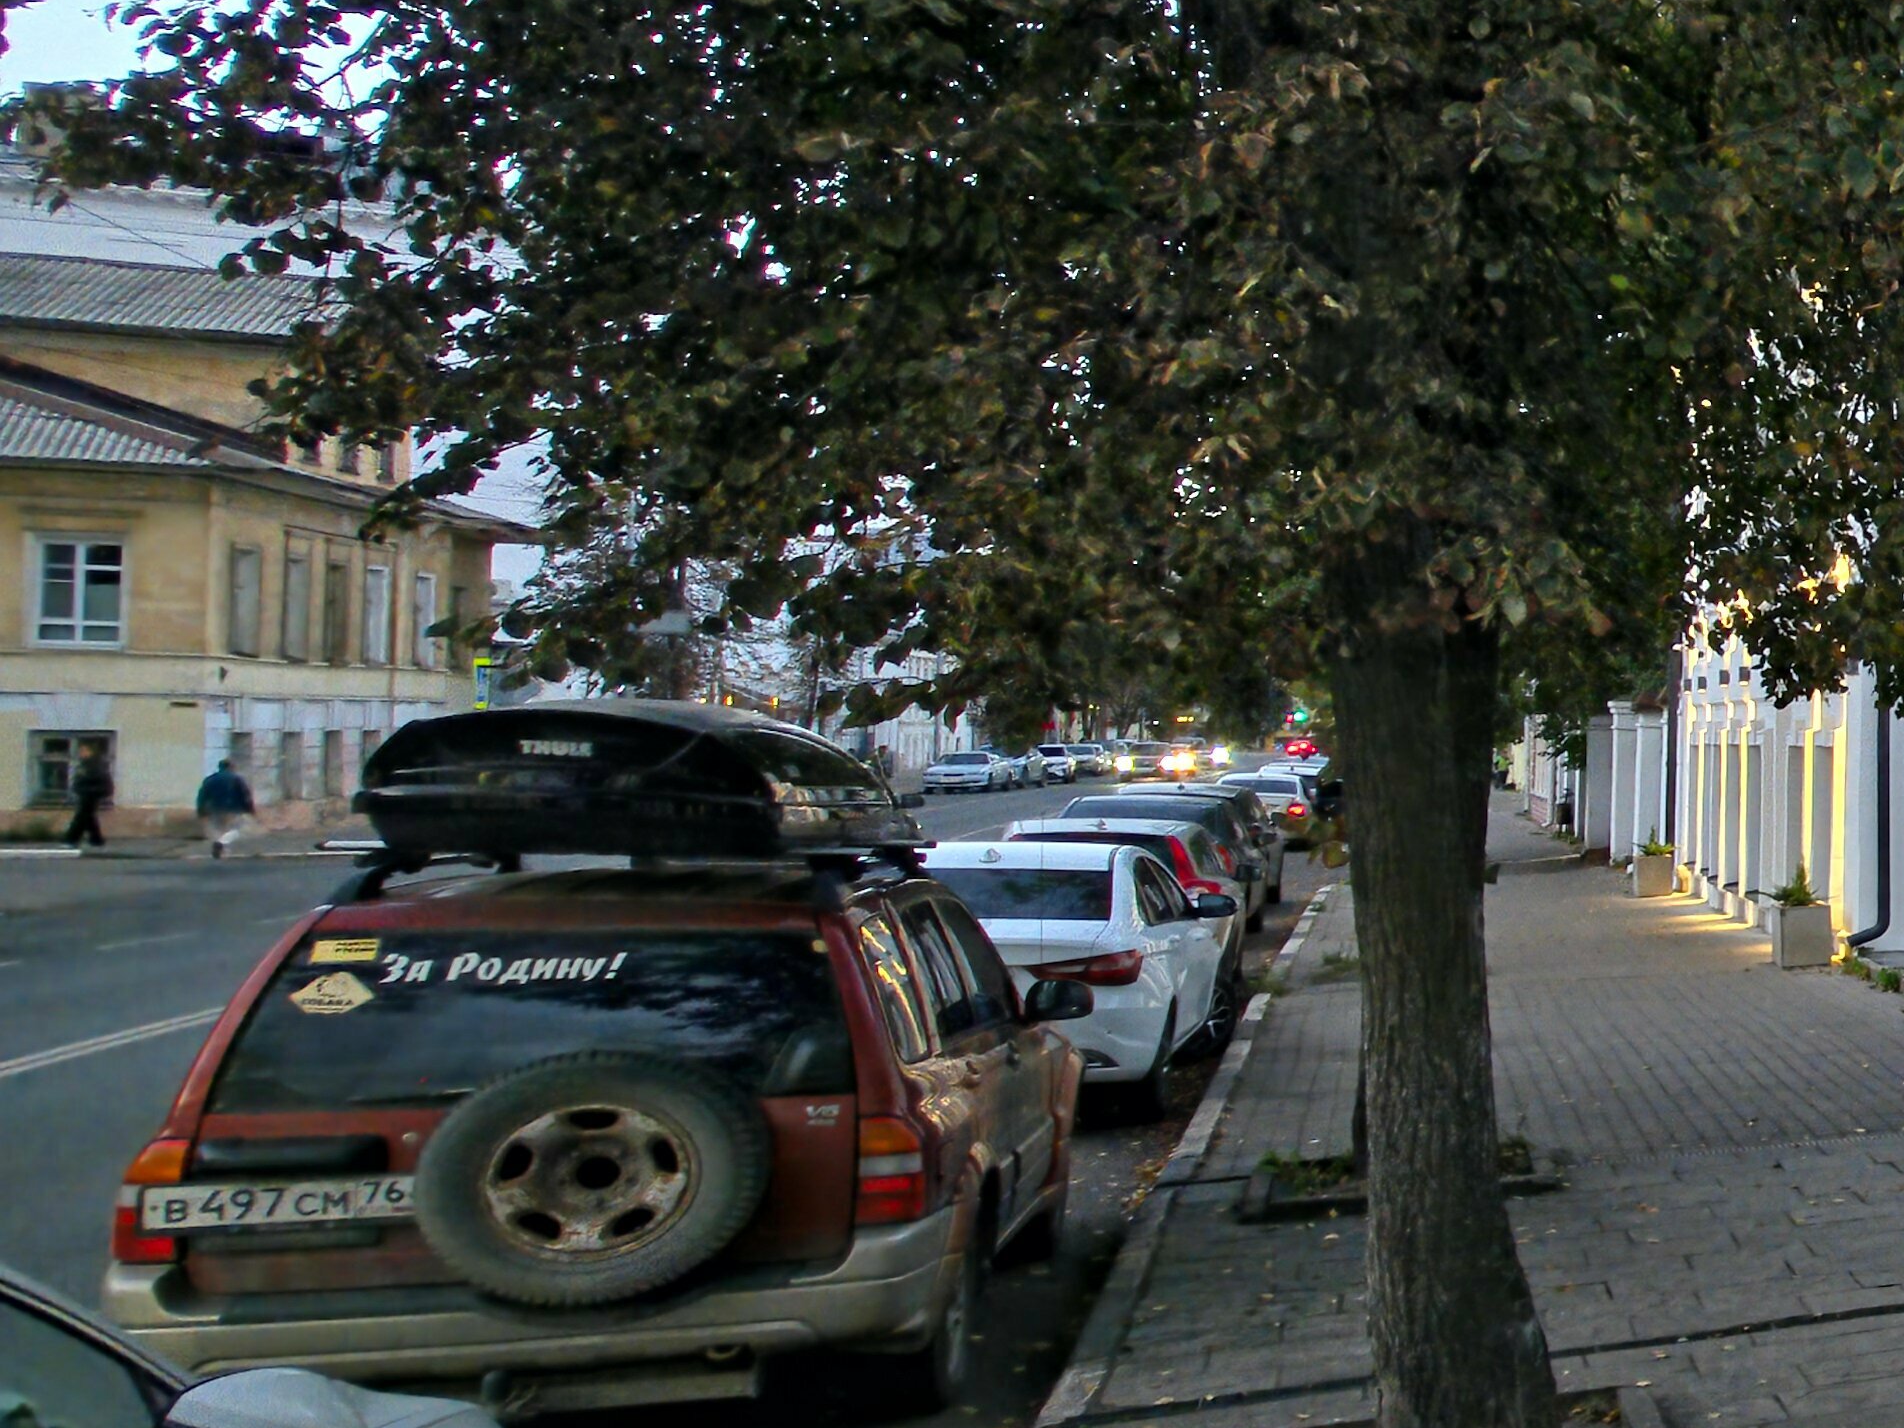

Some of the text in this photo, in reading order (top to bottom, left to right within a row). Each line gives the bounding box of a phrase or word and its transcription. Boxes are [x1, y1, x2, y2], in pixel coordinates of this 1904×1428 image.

[519, 739, 592, 757] THULE
[379, 952, 628, 985] За Родину!
